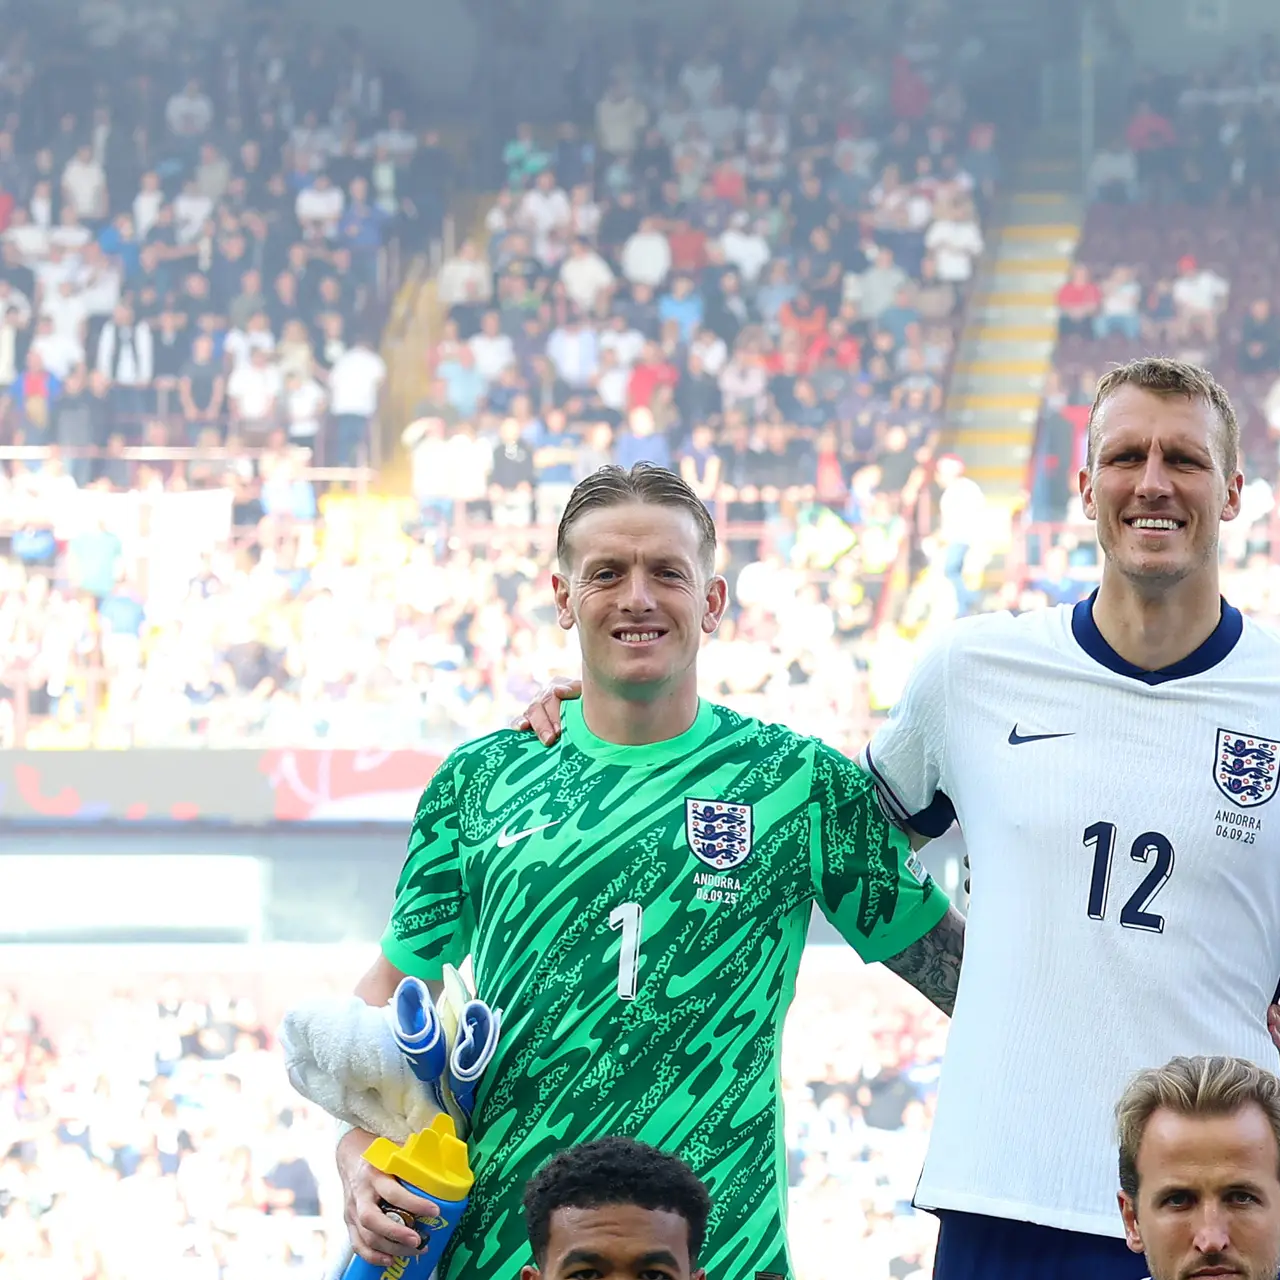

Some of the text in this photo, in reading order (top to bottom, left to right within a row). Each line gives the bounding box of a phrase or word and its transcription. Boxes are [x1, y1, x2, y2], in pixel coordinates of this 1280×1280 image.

[1214, 809, 1262, 831] ANDORRA
[1215, 824, 1256, 844] 06.09.25
[692, 872, 741, 890] ANDORRA
[1083, 821, 1175, 934] 12
[609, 903, 642, 1000] 1
